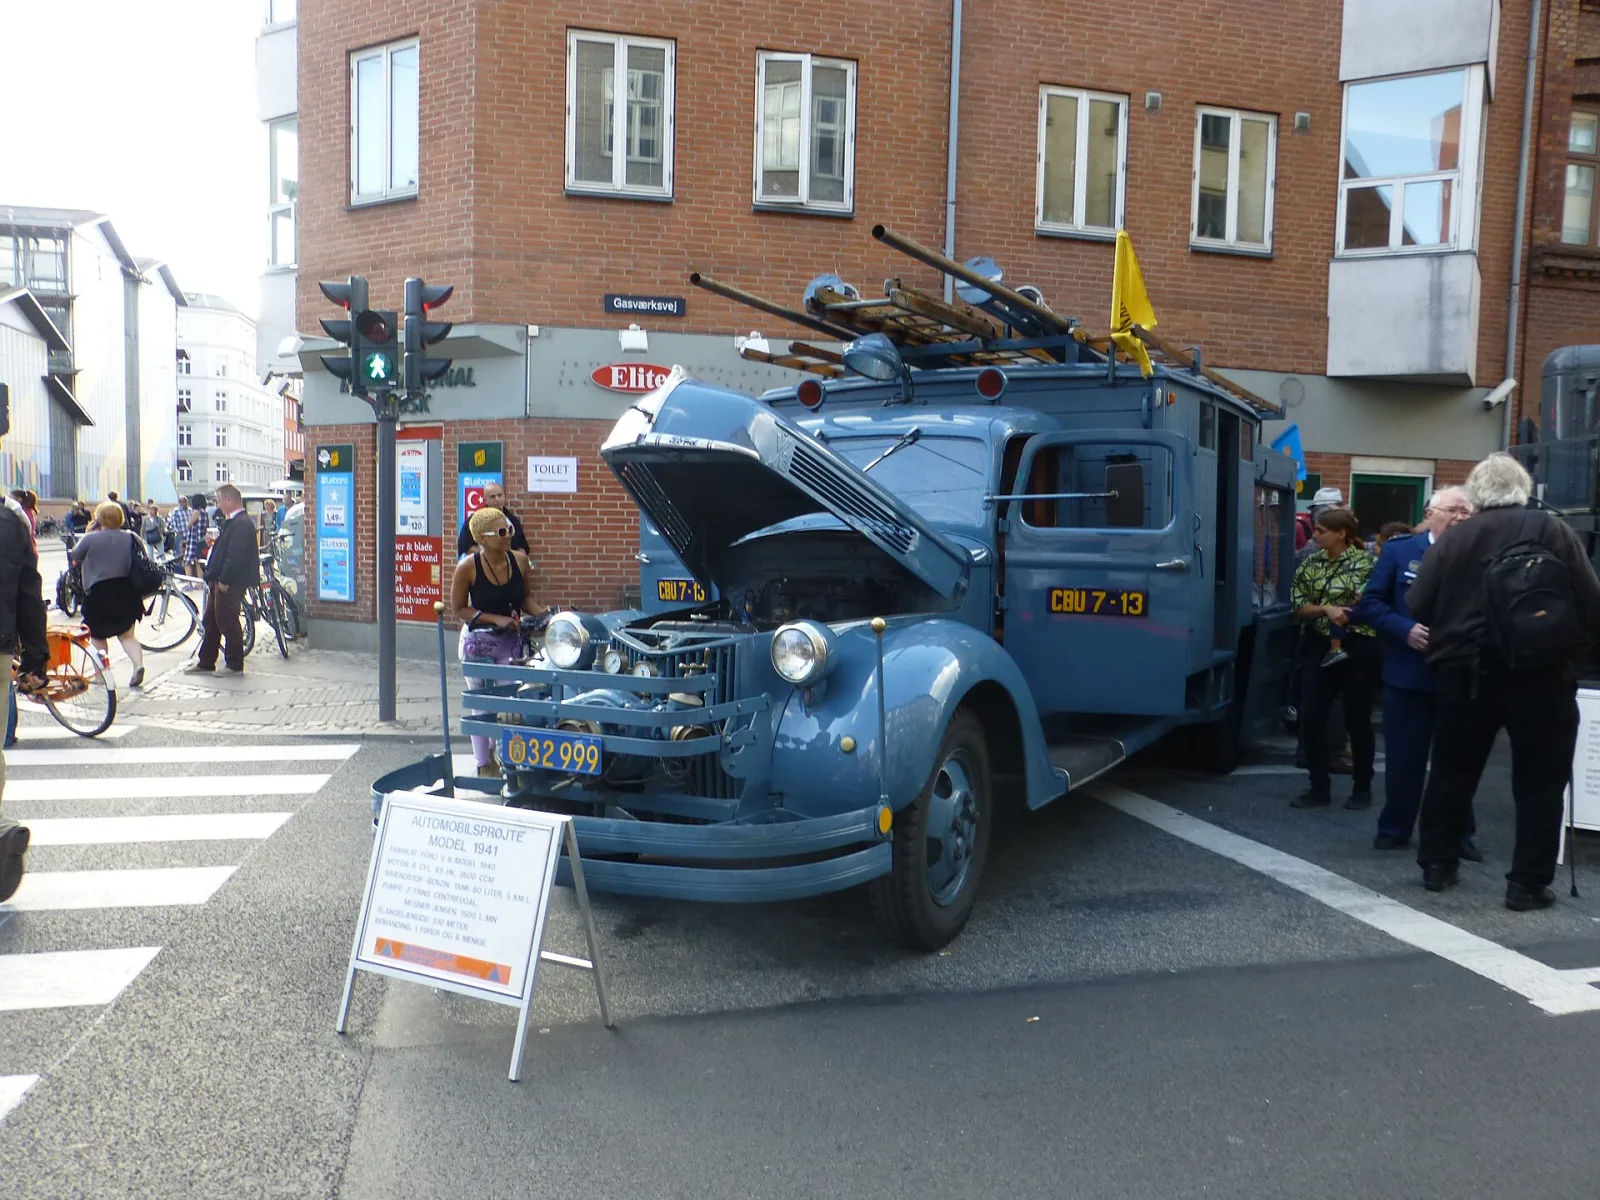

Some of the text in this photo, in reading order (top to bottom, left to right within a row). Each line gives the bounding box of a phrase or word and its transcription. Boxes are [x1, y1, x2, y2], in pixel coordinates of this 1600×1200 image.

[613, 297, 677, 313] Gasværksvej
[610, 366, 667, 389] Elite
[533, 464, 569, 475] TOILET
[414, 541, 433, 552] blade
[421, 553, 438, 563] vand
[414, 585, 440, 597] spiritus
[658, 581, 677, 600] CBU
[395, 595, 429, 605] onialvarer
[1051, 589, 1086, 613] CBU
[527, 738, 599, 773] 32 999
[428, 834, 498, 857] MODEL 1941
[454, 857, 478, 868] MODEL
[478, 874, 495, 884] CCM
[446, 919, 469, 931] METER
[442, 930, 454, 939] OG
